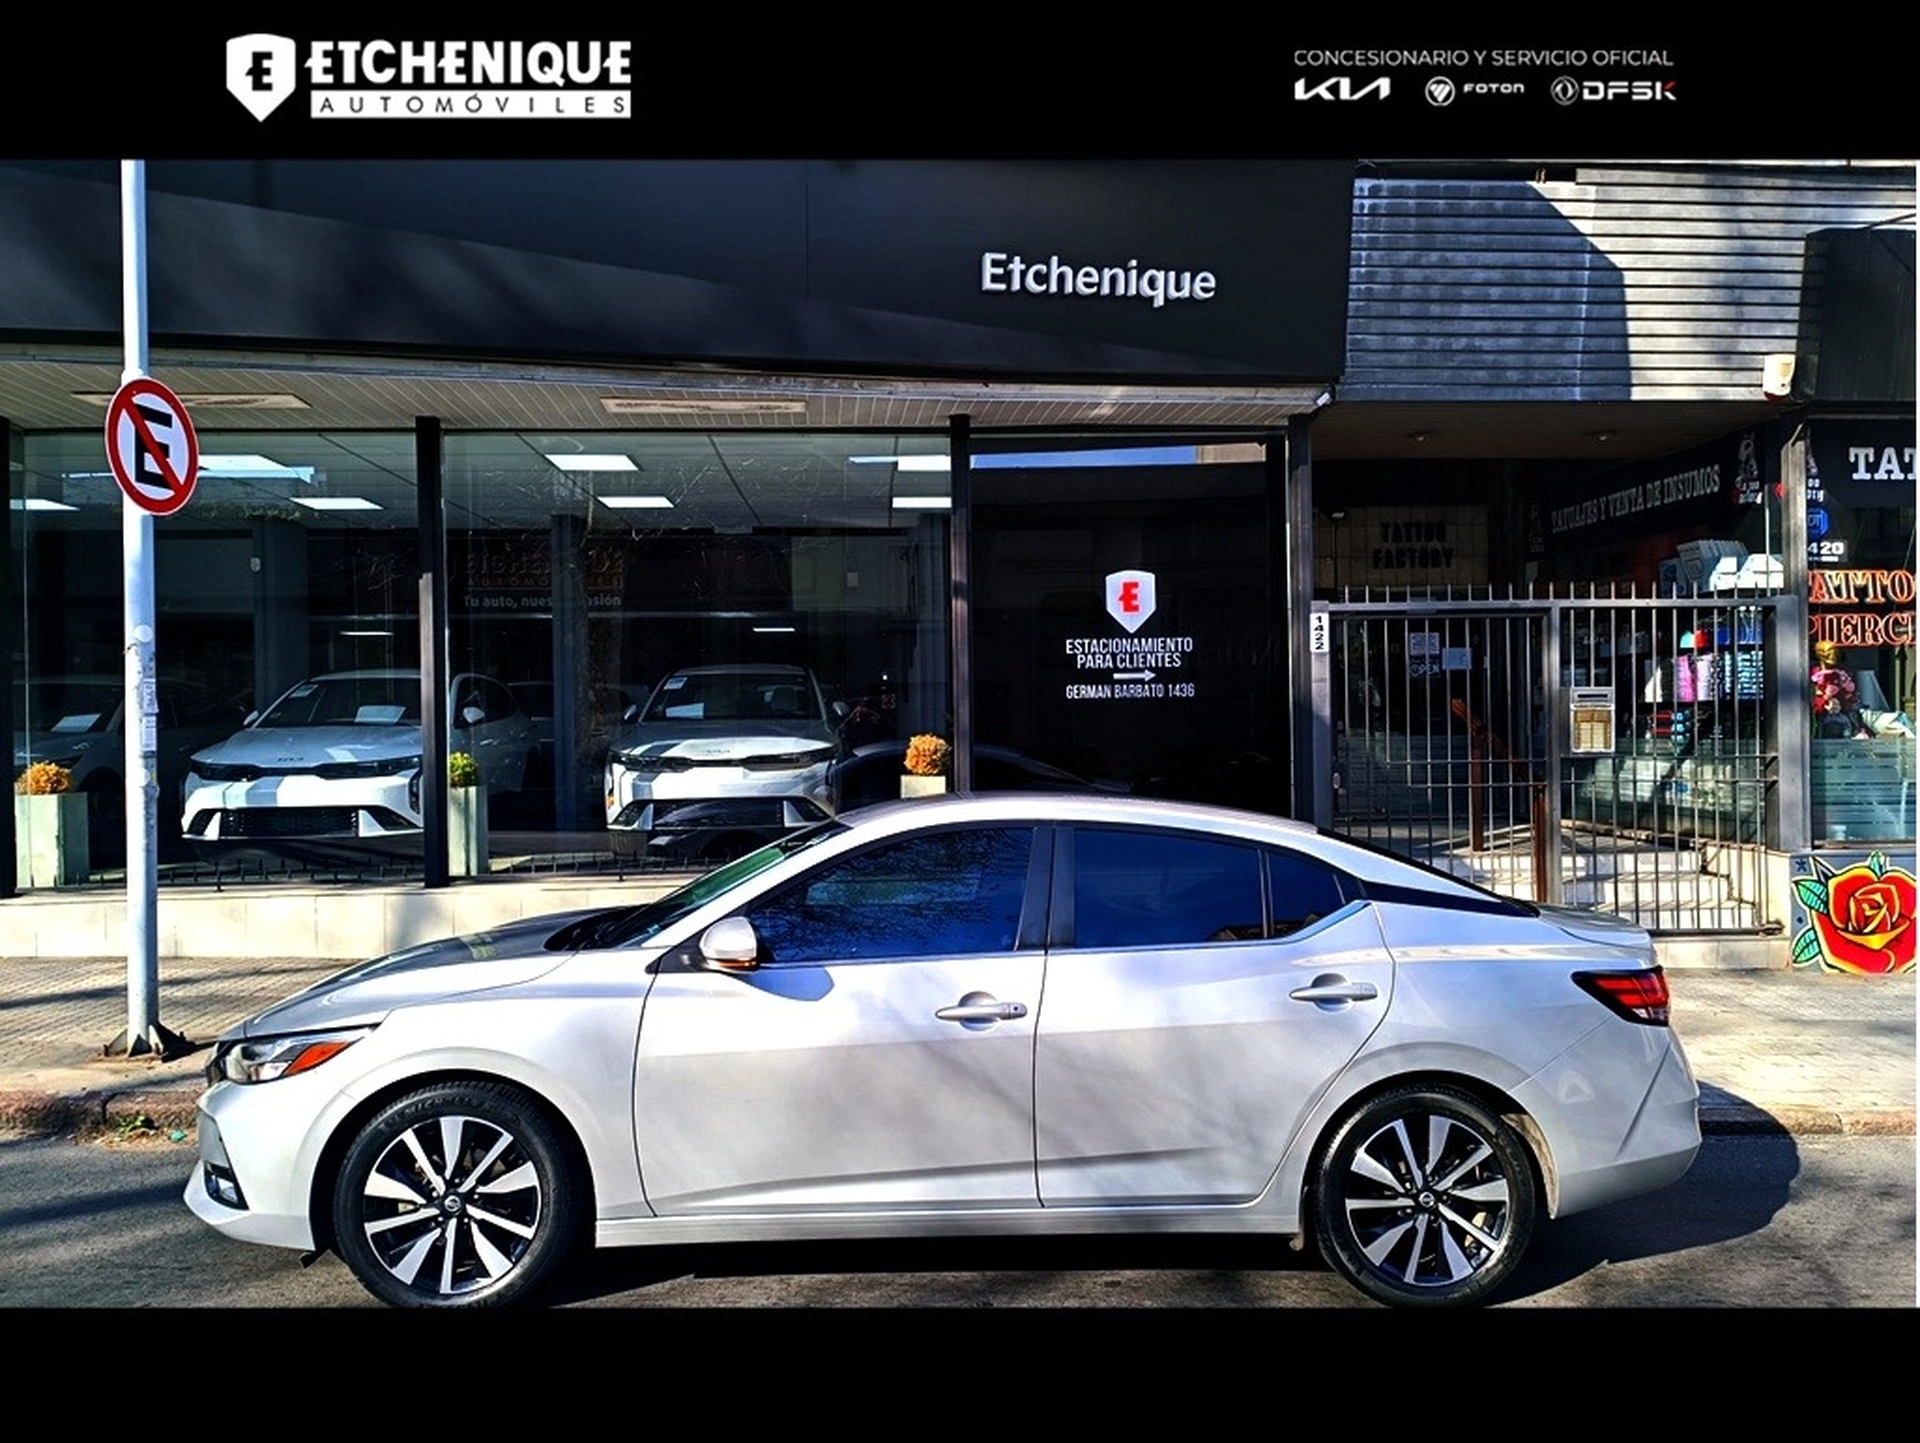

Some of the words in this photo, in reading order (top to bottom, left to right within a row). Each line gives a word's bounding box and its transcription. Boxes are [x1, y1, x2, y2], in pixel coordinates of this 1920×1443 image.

[981, 252, 1217, 308] Etchenique
[1551, 498, 1599, 535] TATUAJES
[1607, 484, 1646, 519] VENTA
[1646, 480, 1663, 510] DE
[1663, 463, 1722, 505] INSUMOS
[1807, 541, 1844, 555] 420
[1807, 569, 1916, 603] ATTO
[1314, 615, 1324, 650] 1422
[1065, 637, 1193, 655] ESTACIONAMIENTO
[1077, 653, 1114, 669] PARA
[1116, 652, 1182, 669] CLIENTES
[1065, 684, 1112, 699] GERMAN
[1114, 684, 1164, 699] BARBATO
[1168, 682, 1195, 698] 1436
